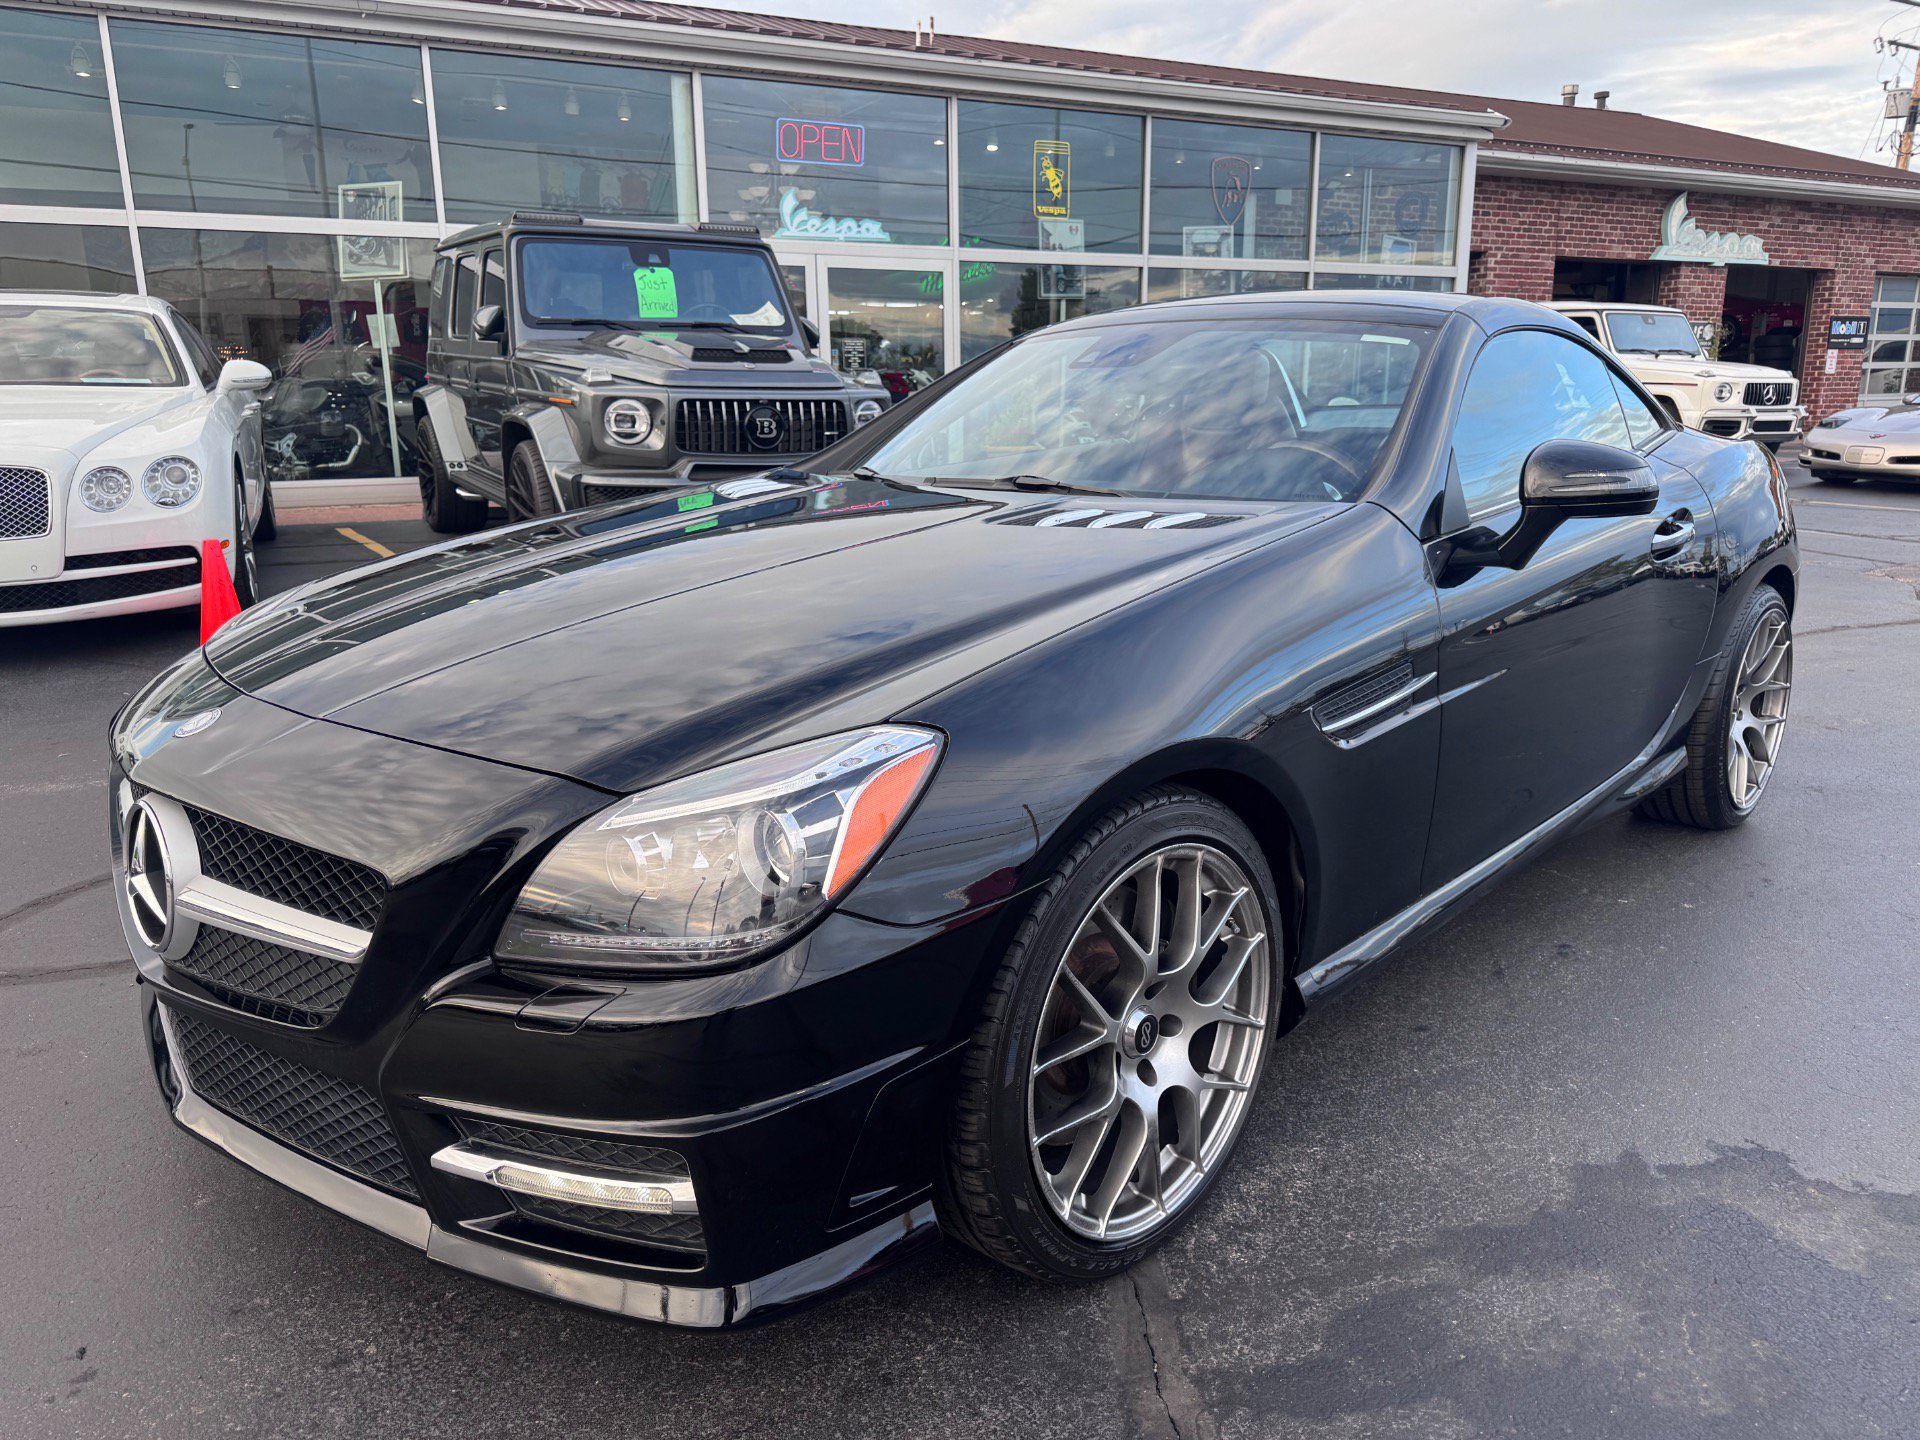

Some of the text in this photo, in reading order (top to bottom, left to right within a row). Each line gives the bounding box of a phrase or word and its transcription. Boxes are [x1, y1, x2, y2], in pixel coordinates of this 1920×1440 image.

[780, 122, 861, 163] OPEN
[777, 188, 891, 242] Vespa
[1652, 191, 1769, 265] Vespa
[638, 274, 668, 290] Just
[1831, 320, 1858, 335] Mobil
